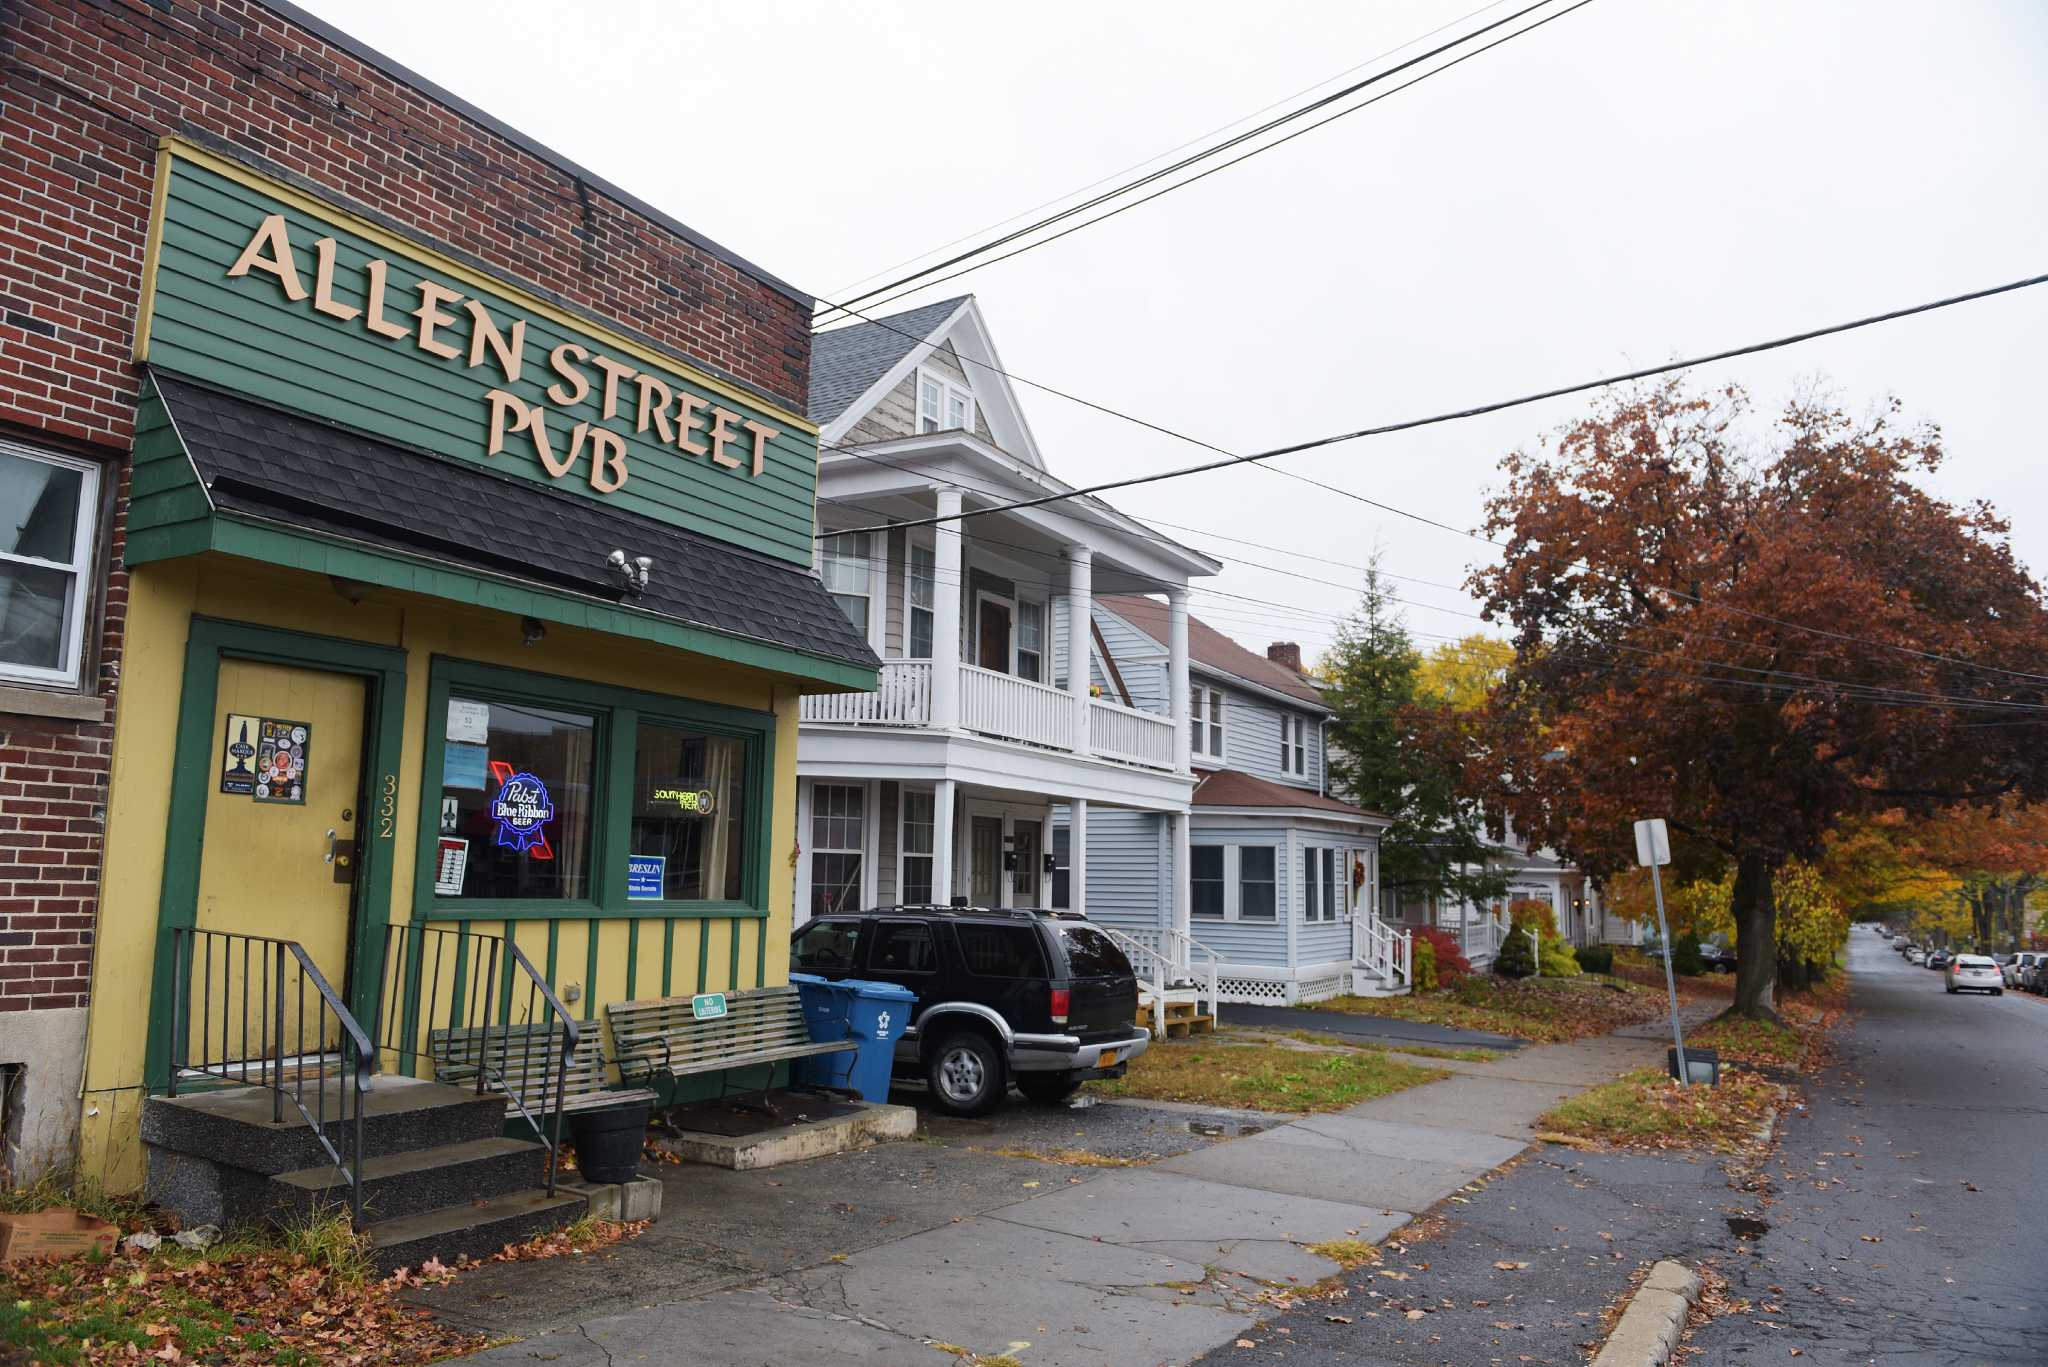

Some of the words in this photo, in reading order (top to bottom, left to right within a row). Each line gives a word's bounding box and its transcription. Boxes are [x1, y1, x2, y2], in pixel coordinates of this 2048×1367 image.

[226, 214, 526, 383] ALLEN
[546, 342, 780, 478] STREET
[484, 389, 630, 494] PUB
[508, 781, 541, 804] Pabst
[654, 789, 698, 802] SOUTHERN
[380, 774, 396, 838] 332
[497, 803, 517, 817] Blue
[518, 804, 549, 818] Ribbon
[704, 997, 714, 1007] NO
